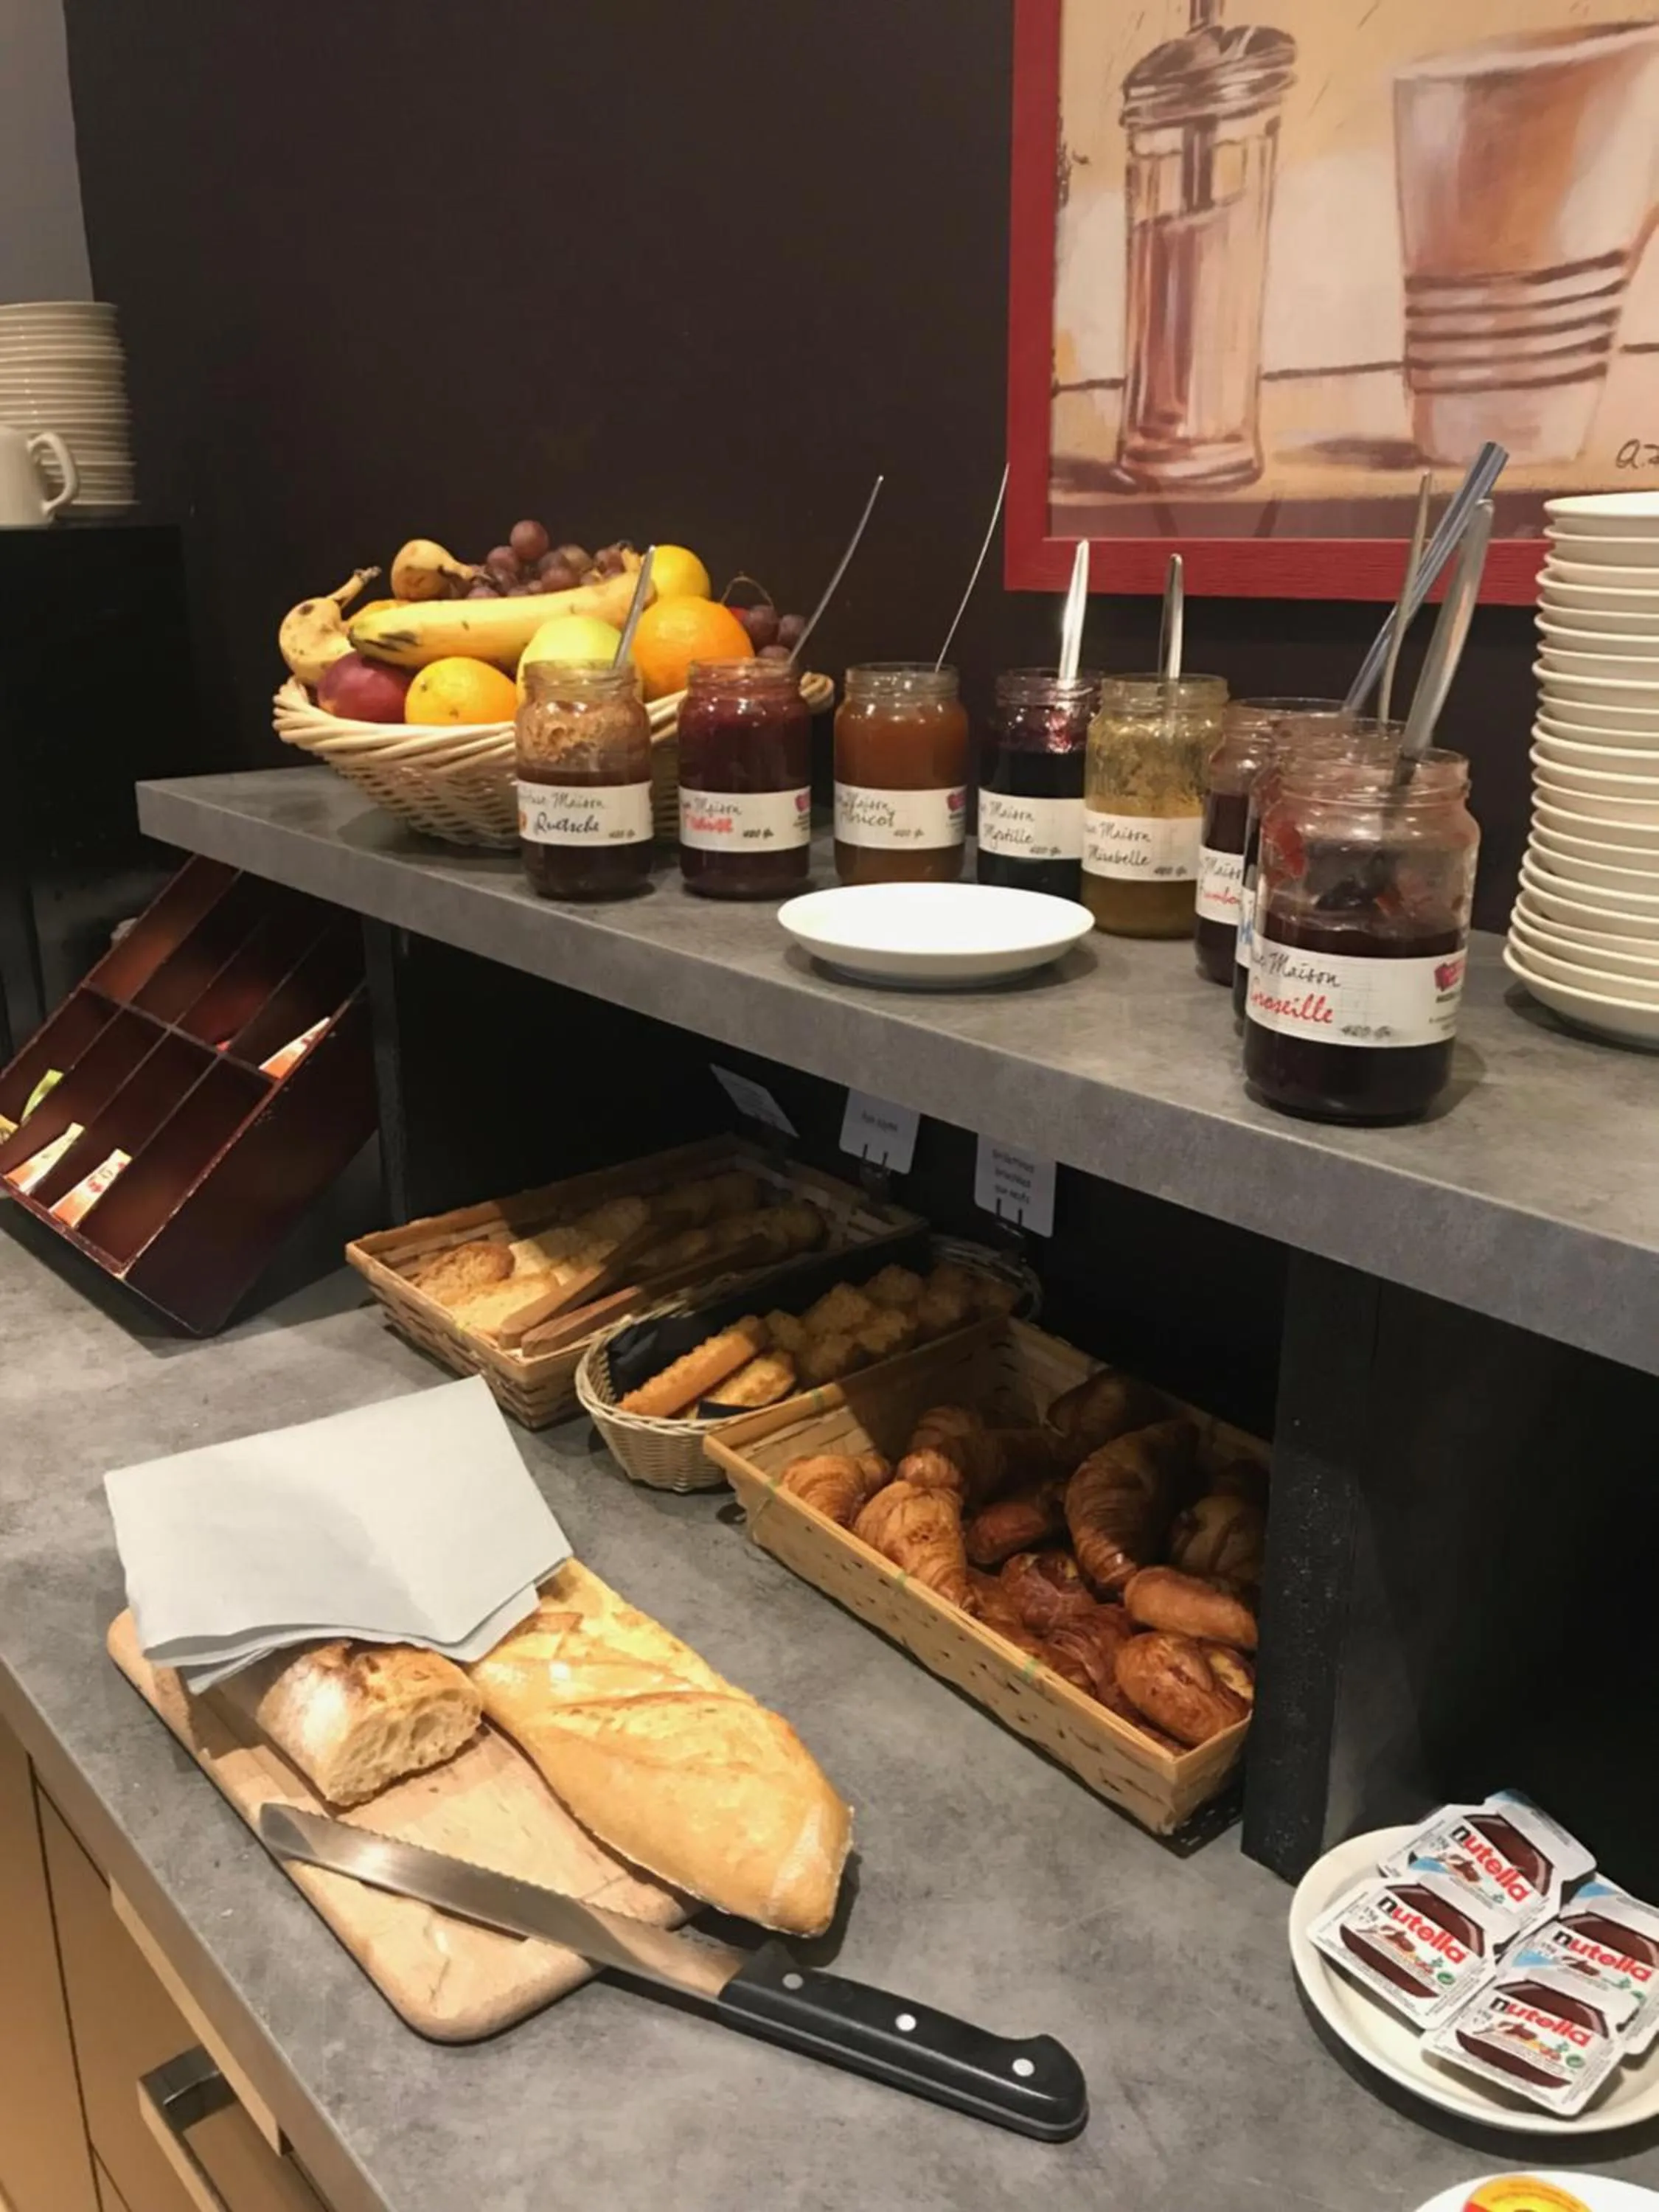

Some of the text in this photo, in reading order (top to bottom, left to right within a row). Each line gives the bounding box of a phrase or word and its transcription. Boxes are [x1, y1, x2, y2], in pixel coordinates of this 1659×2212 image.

[534, 812, 599, 836] Quetsche
[1099, 821, 1151, 843] Maison
[1088, 844, 1150, 866] Mirabelle
[1269, 952, 1341, 987] Maison
[1450, 1825, 1531, 1902] nutella
[1377, 1896, 1467, 1964] nutella
[1553, 1930, 1652, 1983] nutella
[1489, 1997, 1592, 2047] nutella
